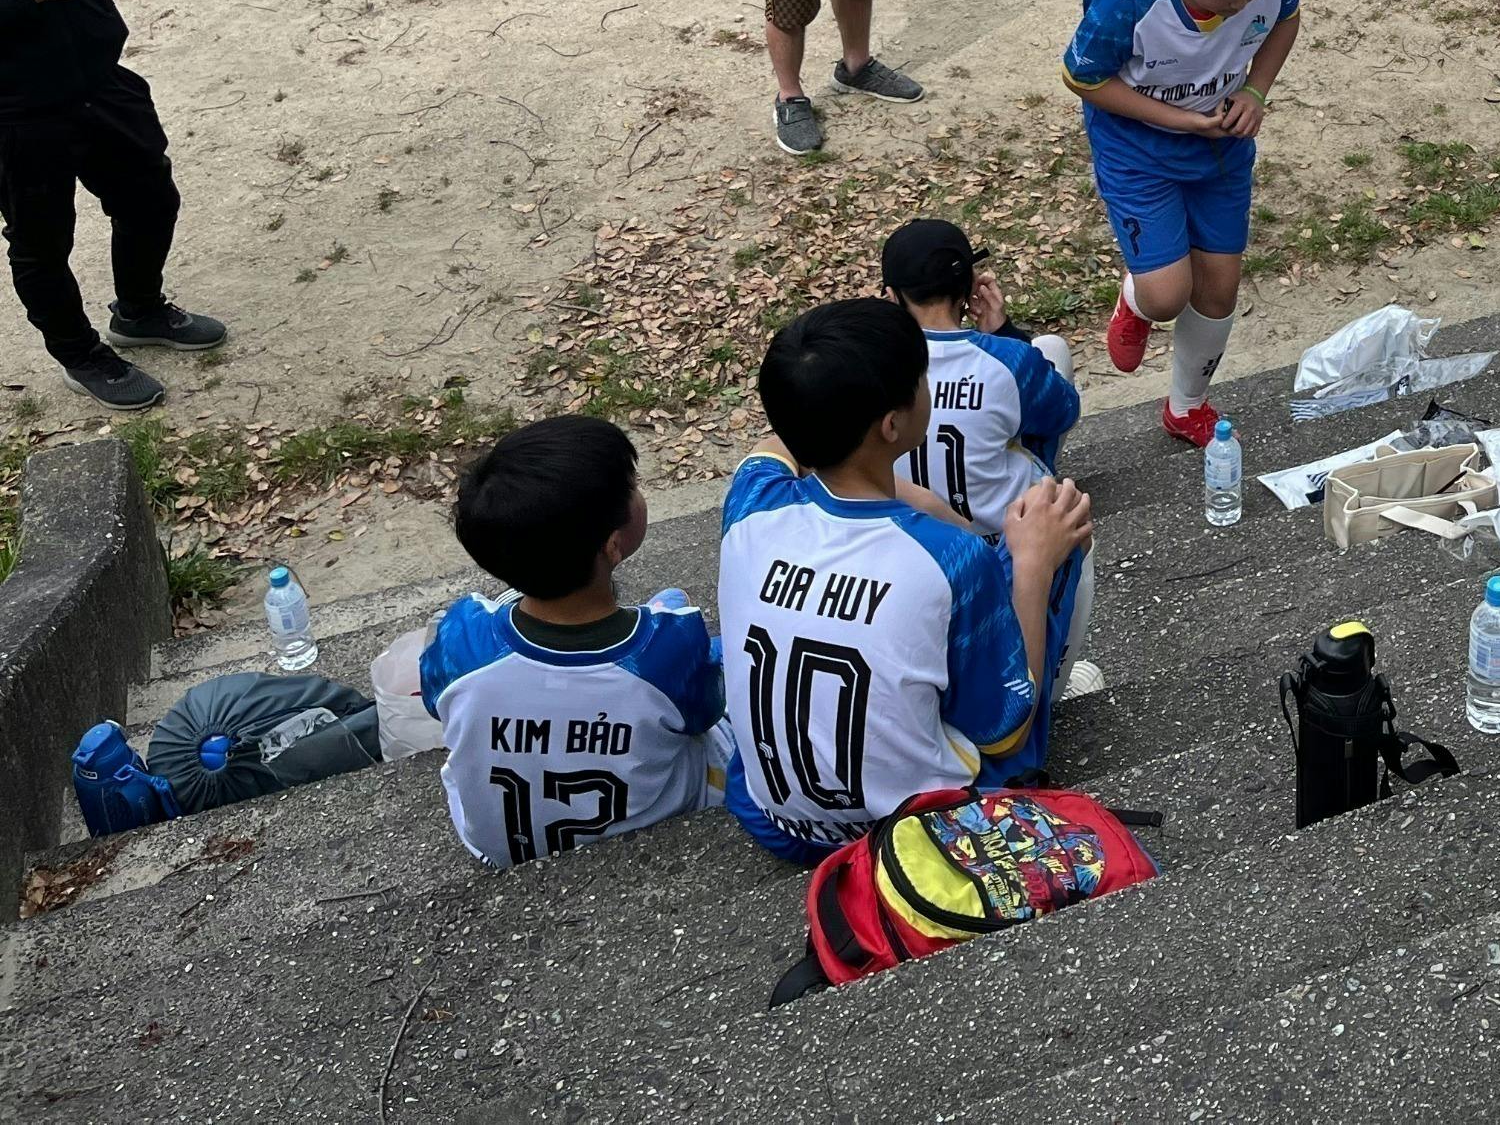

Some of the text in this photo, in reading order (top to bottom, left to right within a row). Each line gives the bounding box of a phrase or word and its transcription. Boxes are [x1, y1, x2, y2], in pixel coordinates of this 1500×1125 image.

[934, 375, 984, 411] HIẾU
[759, 559, 892, 625] GIA HUY
[491, 712, 633, 756] KIM BẢO
[743, 623, 872, 810] 10
[490, 765, 629, 866] 12
